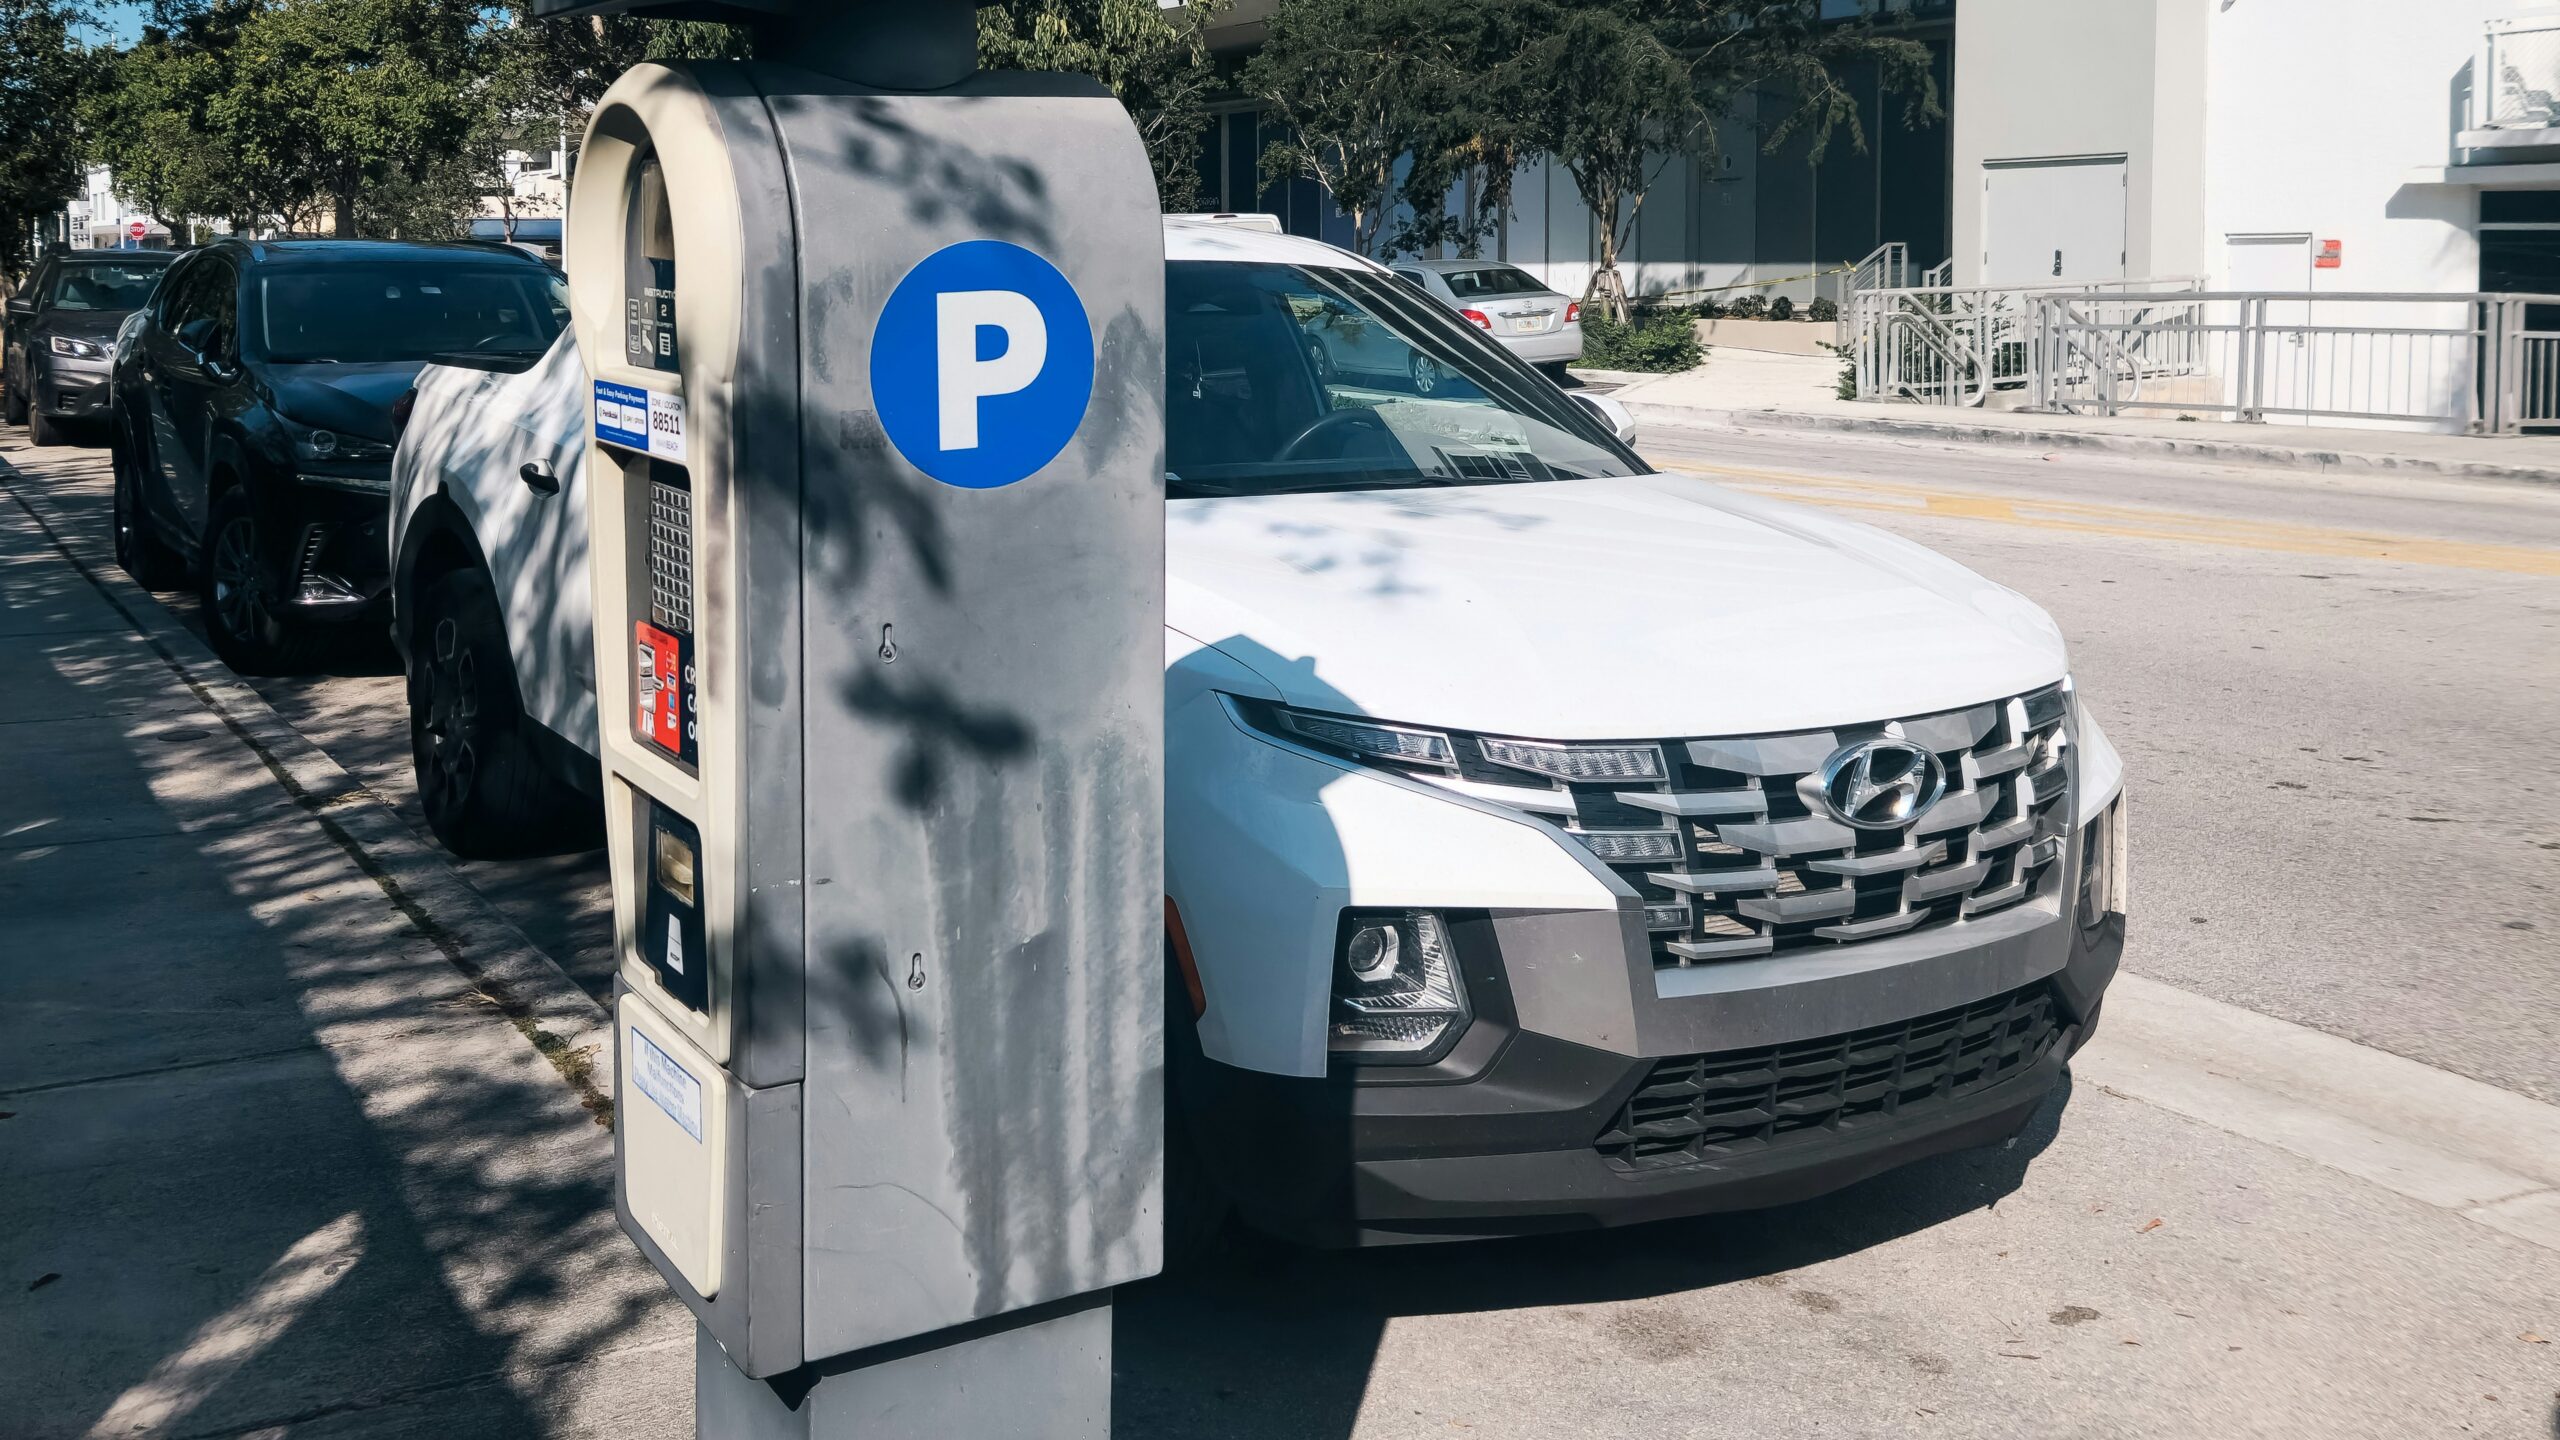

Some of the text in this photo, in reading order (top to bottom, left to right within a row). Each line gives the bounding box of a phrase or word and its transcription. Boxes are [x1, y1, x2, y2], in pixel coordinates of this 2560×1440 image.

[644, 301, 667, 316] 1 2
[936, 290, 1047, 451] P
[615, 389, 628, 403] Parking
[652, 410, 681, 435] 88511
